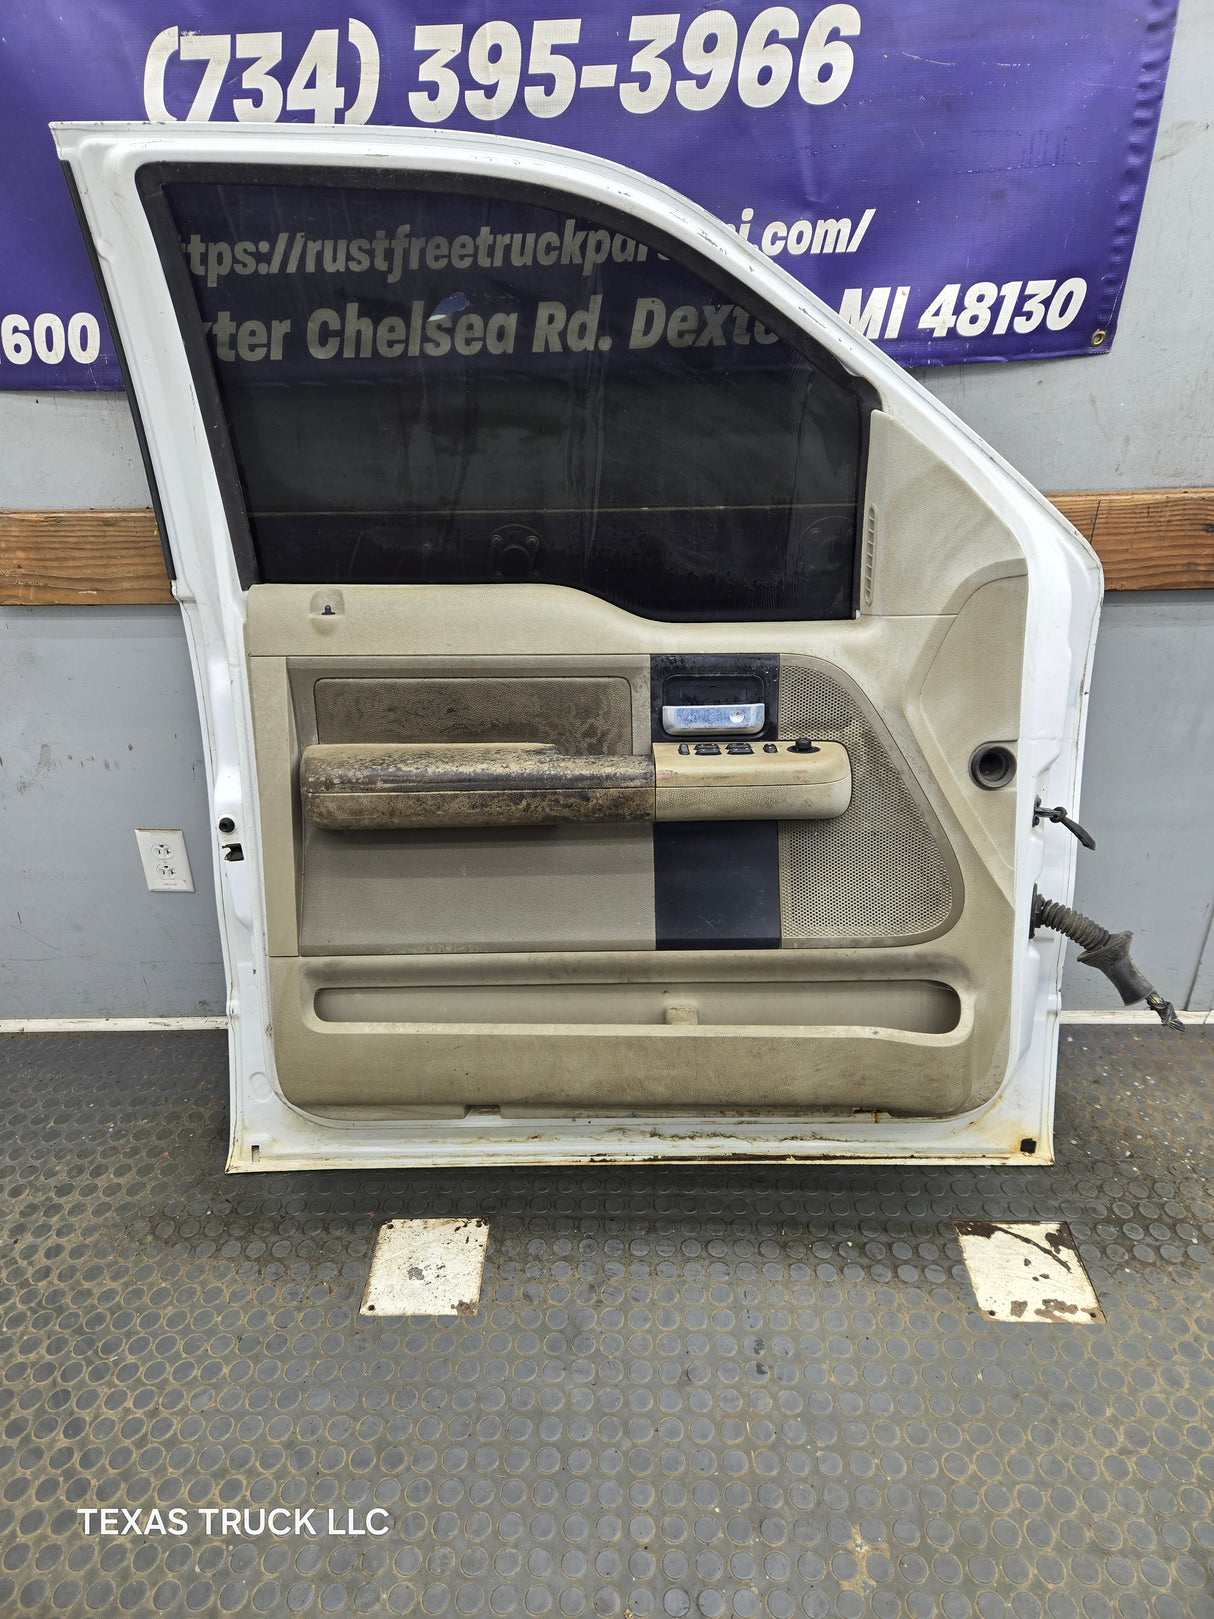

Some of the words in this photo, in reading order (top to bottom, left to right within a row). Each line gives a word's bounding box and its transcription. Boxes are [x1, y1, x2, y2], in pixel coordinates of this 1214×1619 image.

[143, 17, 380, 125] (734)
[408, 3, 862, 123] 395-3966
[0, 312, 101, 365] 600
[306, 302, 516, 360] Chelsea
[532, 294, 613, 352] Rd.
[838, 285, 911, 340] MI
[918, 277, 1087, 338] 48130
